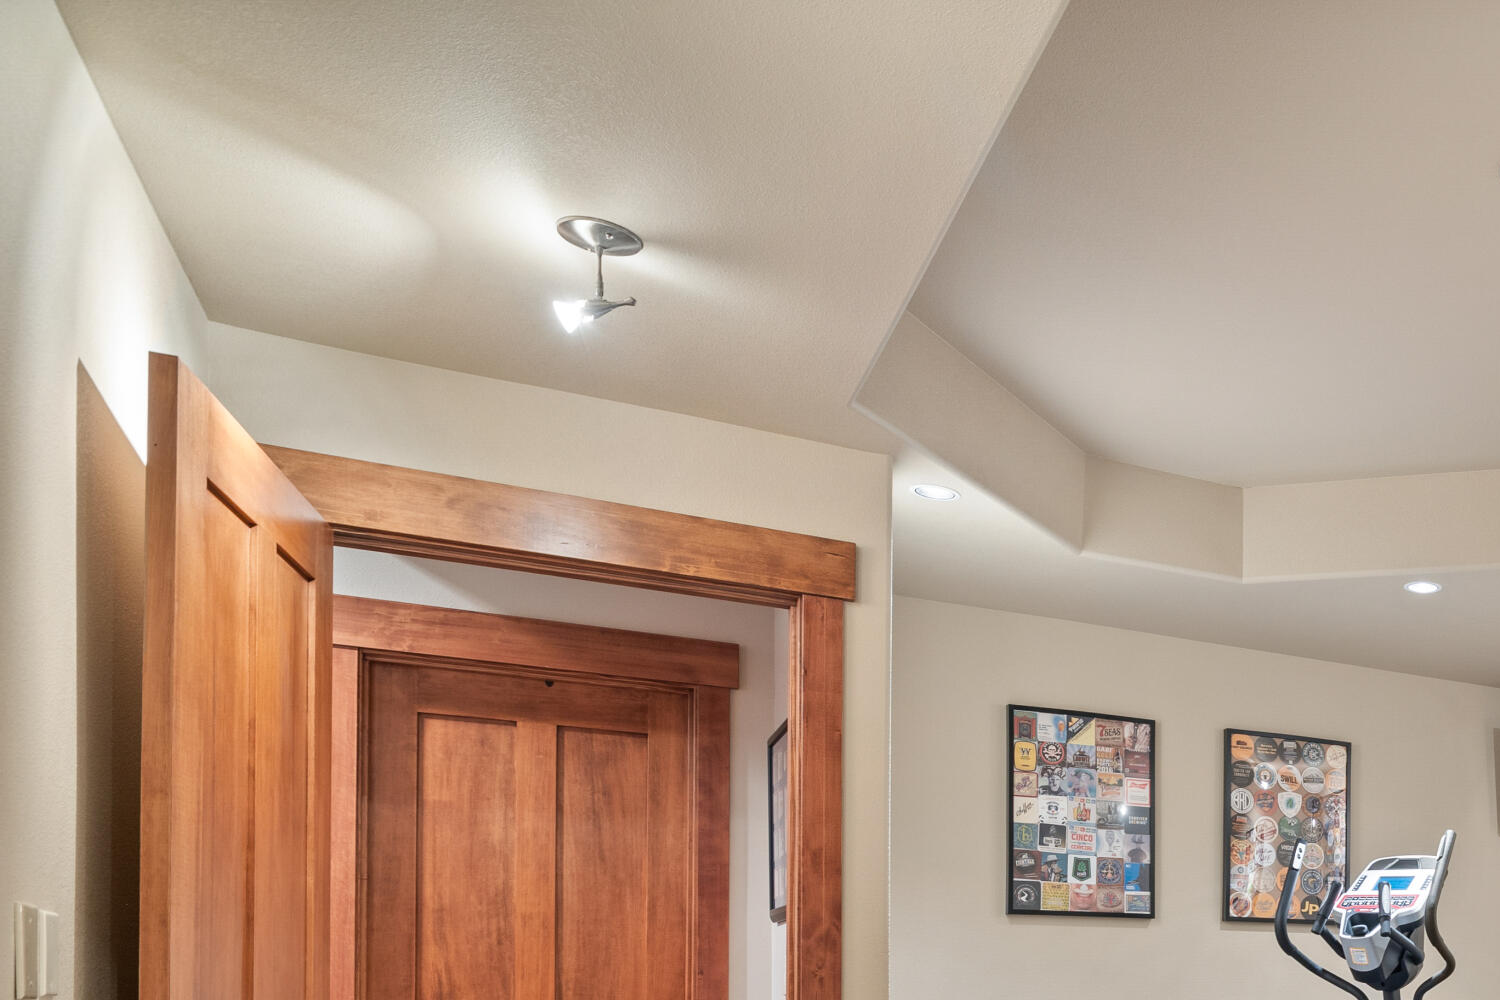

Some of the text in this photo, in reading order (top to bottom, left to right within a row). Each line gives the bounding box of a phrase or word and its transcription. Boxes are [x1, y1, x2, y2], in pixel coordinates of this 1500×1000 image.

[1104, 727, 1121, 737] SEAS
[1280, 775, 1297, 784] SWILL
[1071, 833, 1093, 842] CINCO
